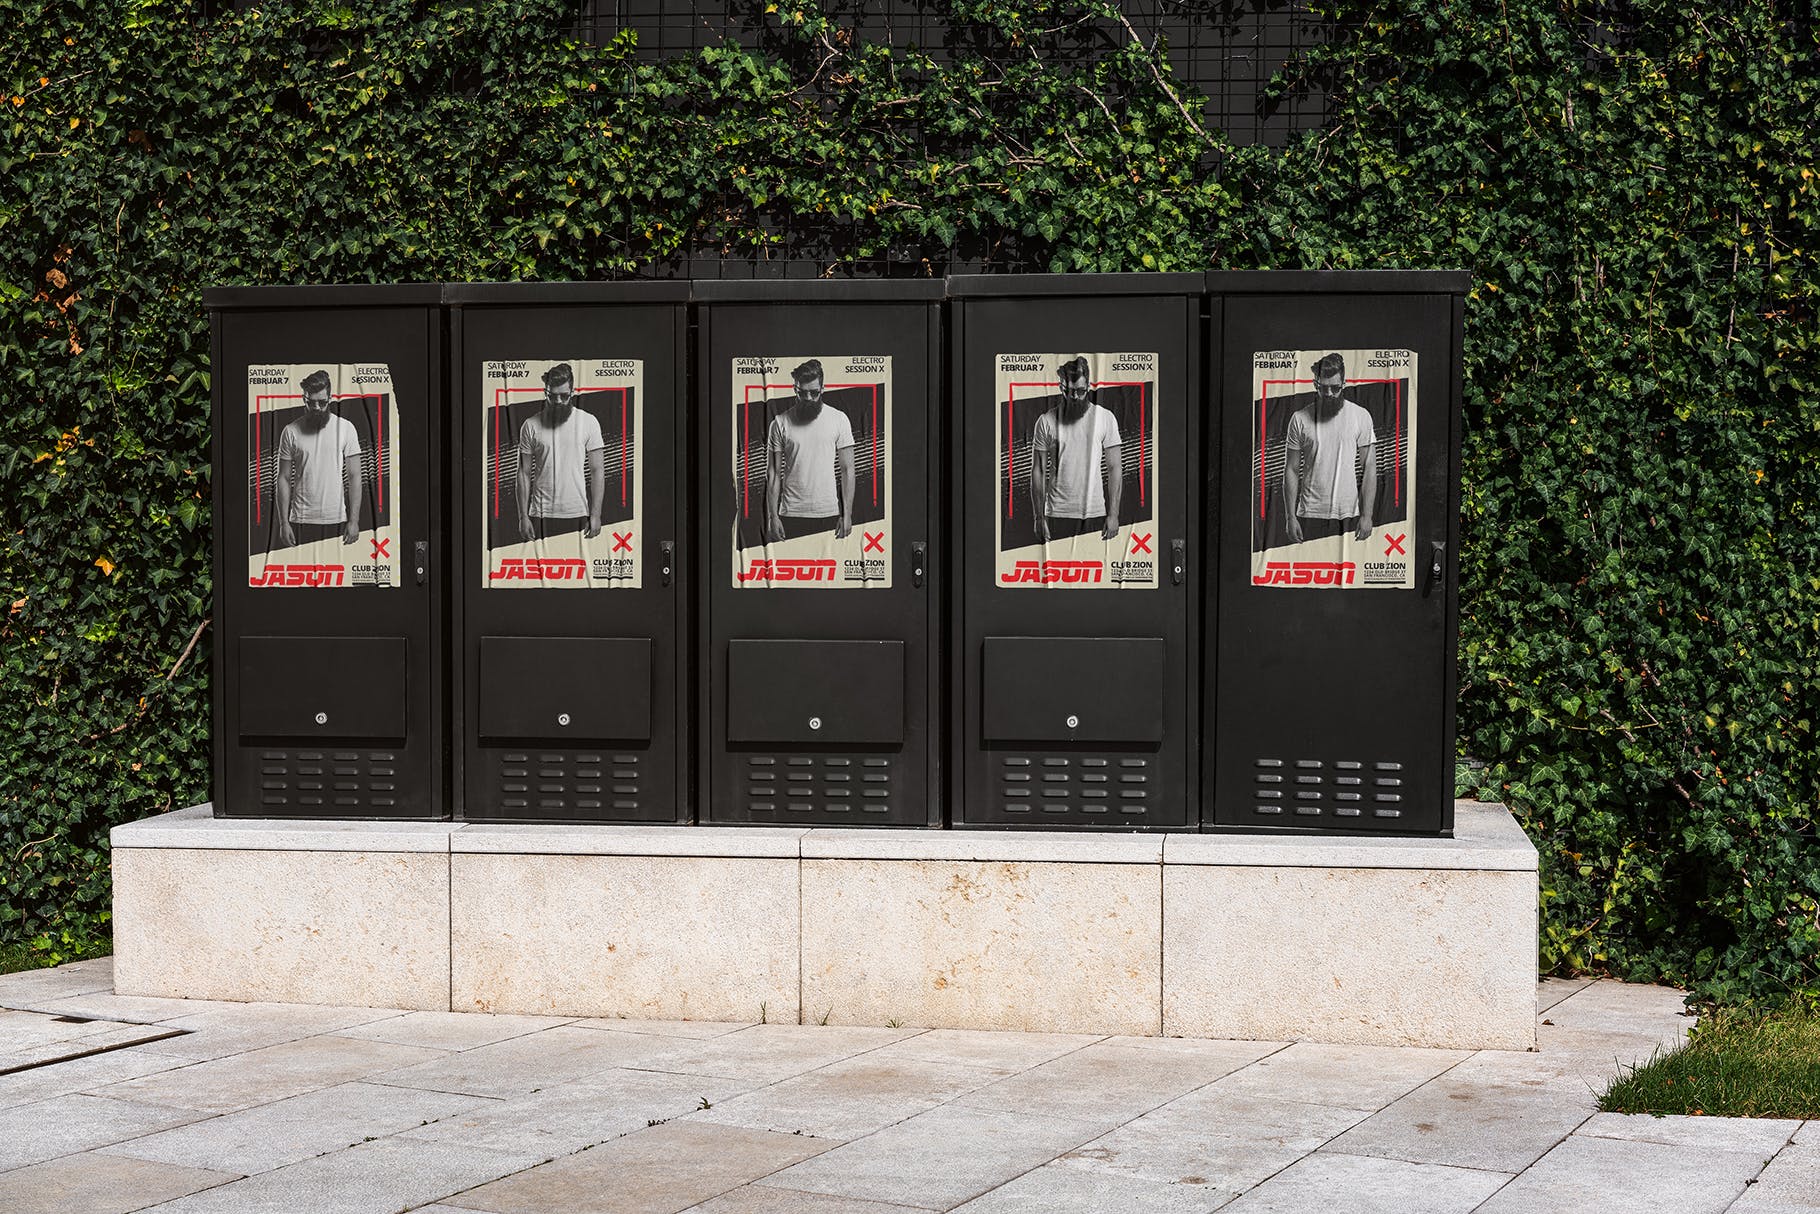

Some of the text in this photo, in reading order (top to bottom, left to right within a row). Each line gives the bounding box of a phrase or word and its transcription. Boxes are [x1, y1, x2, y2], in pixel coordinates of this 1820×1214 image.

[1001, 355, 1041, 363] SATURDAY
[1119, 354, 1152, 362] ELECTRO
[1254, 352, 1296, 360] SATURDAY
[602, 360, 634, 368] ELECTRO
[1001, 364, 1037, 372] FEBRUAR
[1254, 361, 1292, 369] FEBRUAR
[845, 365, 885, 373] SESSION X
[249, 377, 283, 385] FEBRUAR
[488, 558, 587, 580] JASON
[1111, 561, 1131, 569] CLUB
[737, 559, 837, 582] JASON
[1001, 560, 1103, 584] JASON
[1253, 562, 1356, 585] JASON
[249, 564, 345, 586] JASON
